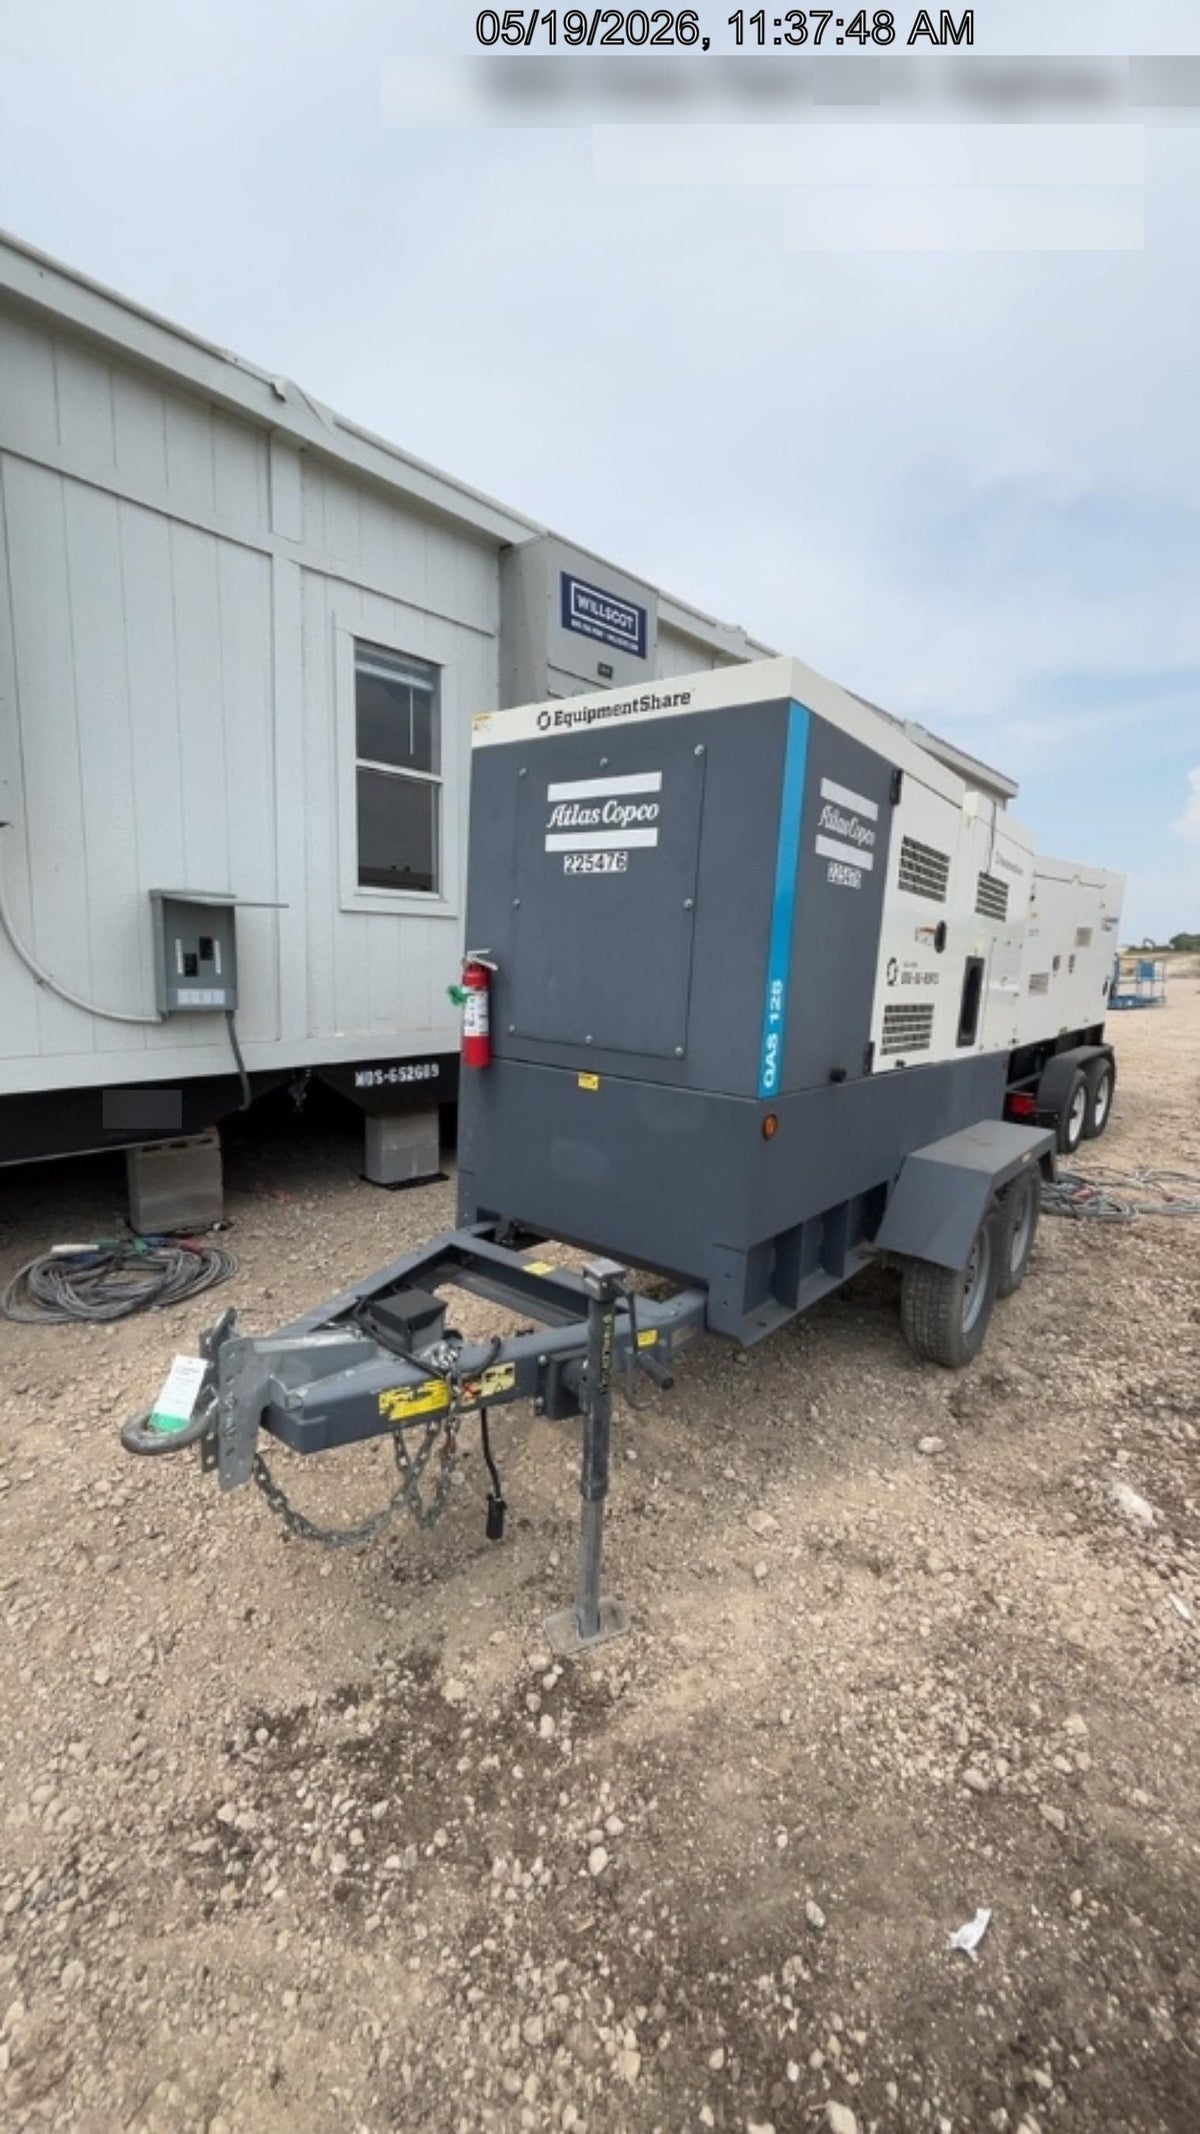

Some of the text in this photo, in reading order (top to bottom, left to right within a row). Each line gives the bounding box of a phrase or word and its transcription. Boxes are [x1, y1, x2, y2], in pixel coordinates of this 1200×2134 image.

[576, 594, 634, 630] WILLSCOT
[554, 692, 691, 727] EquipmentShare
[546, 800, 660, 828] Atlas Copco
[564, 853, 627, 875] 225476
[763, 1033, 779, 1088] QAS
